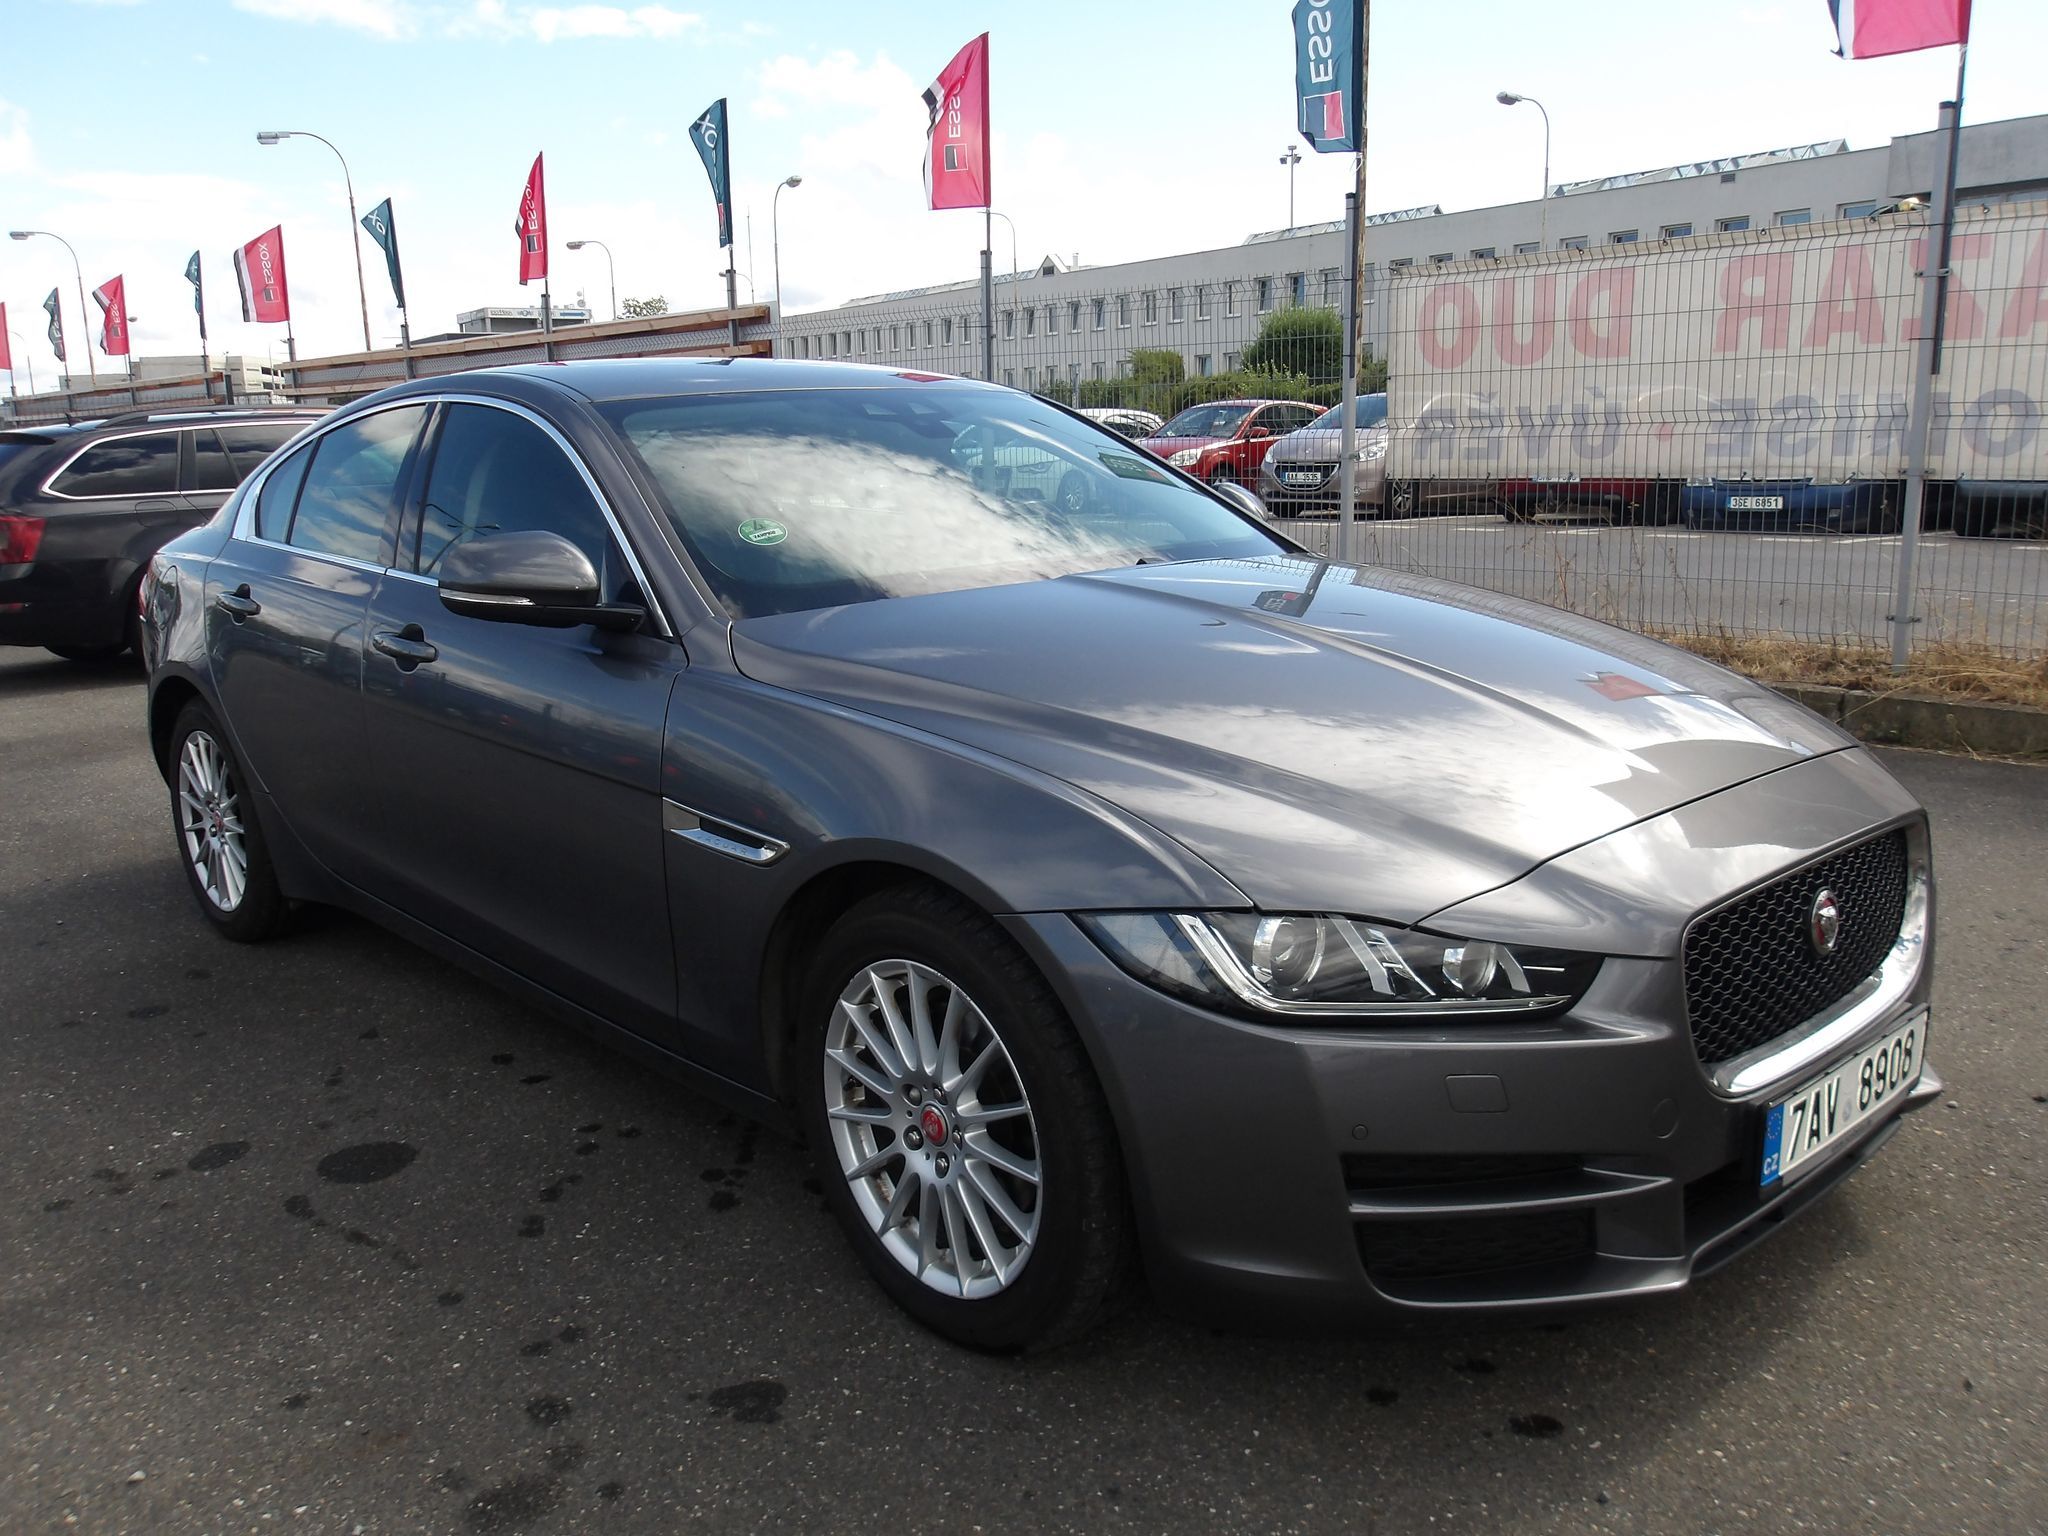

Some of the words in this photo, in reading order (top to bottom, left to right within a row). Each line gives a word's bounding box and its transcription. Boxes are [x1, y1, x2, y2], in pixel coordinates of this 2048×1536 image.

[1732, 498, 1749, 507] 3SE
[1755, 498, 1779, 507] 6851
[1786, 1075, 1840, 1163] 7AV
[1856, 1028, 1915, 1112] 8908
[1763, 1152, 1779, 1175] CZ
